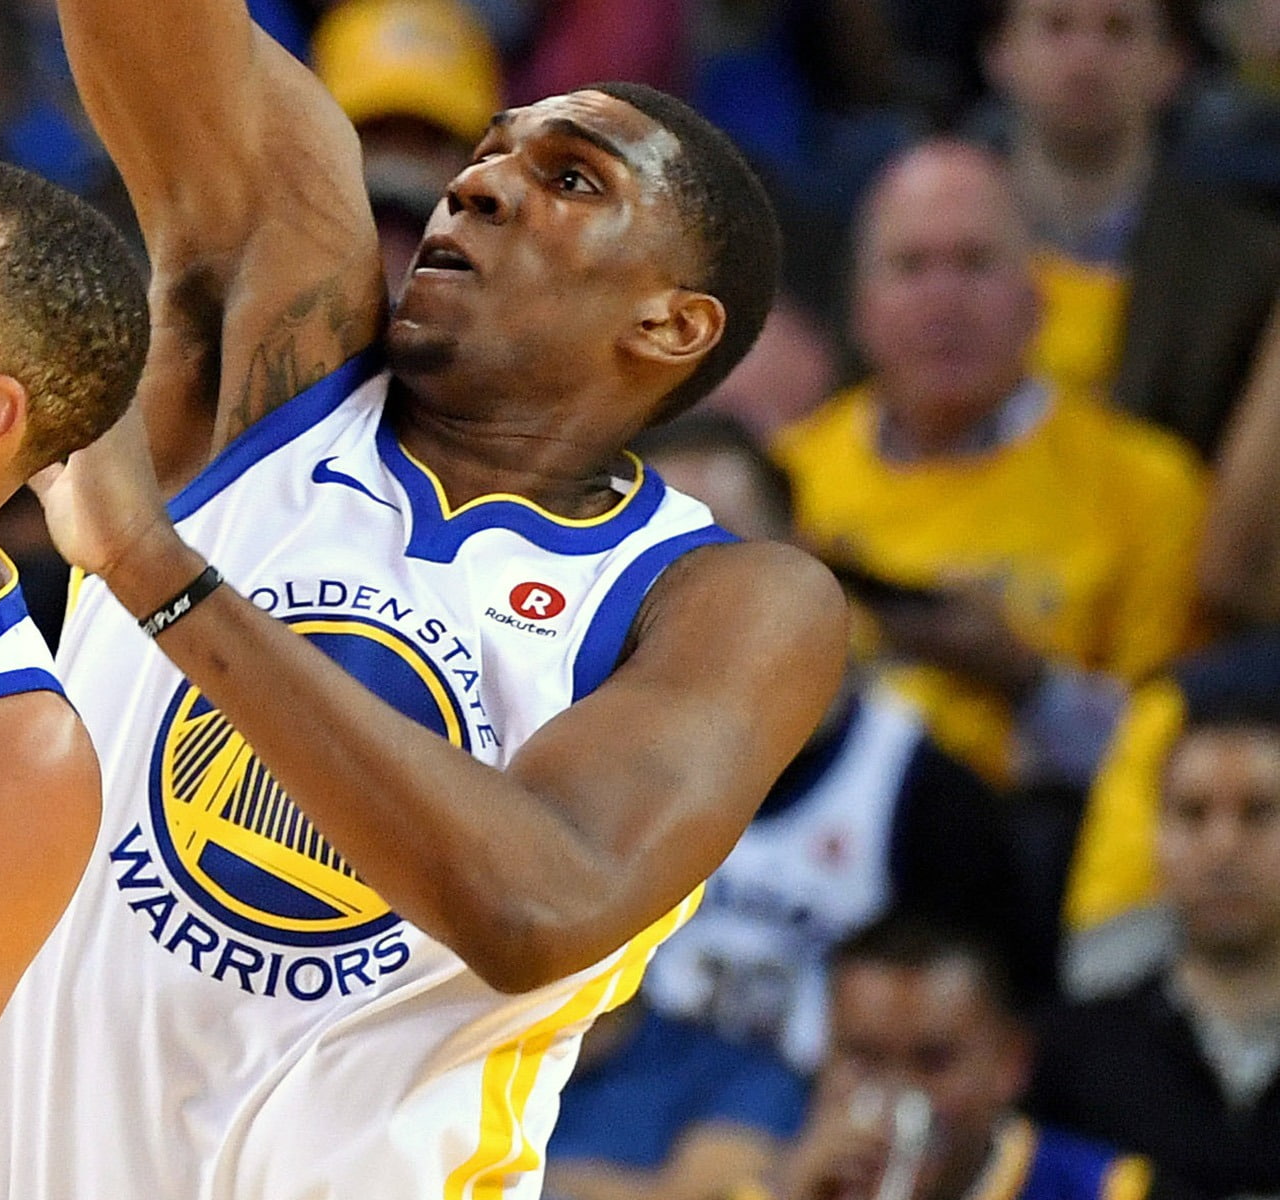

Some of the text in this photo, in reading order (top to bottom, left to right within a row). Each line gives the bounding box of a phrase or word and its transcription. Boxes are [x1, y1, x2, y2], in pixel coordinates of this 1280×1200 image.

[249, 579, 414, 623] OLDEN
[521, 588, 553, 616] R
[484, 606, 558, 638] Rakuten
[108, 822, 411, 1002] WARRIORS
